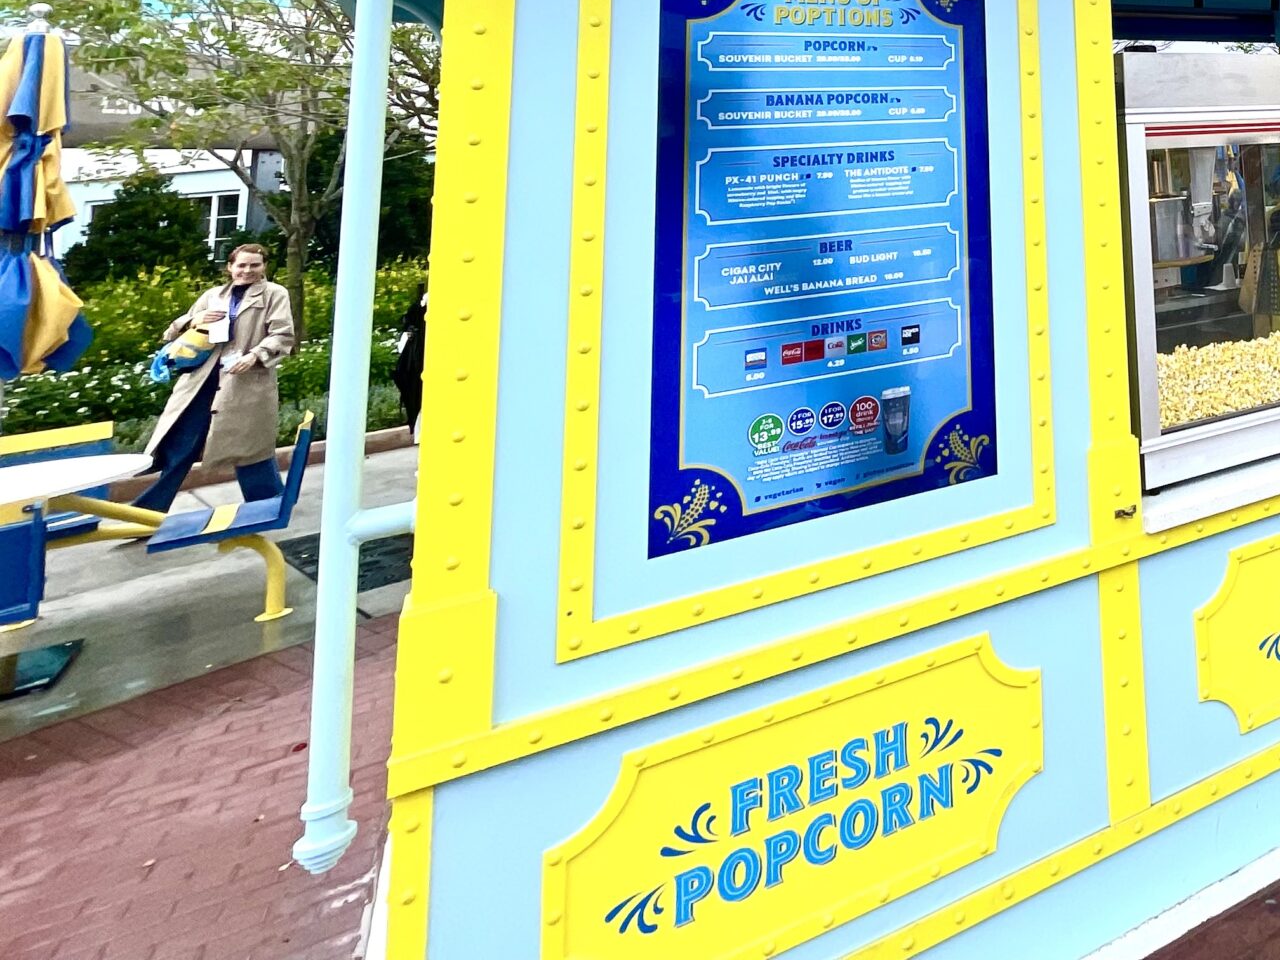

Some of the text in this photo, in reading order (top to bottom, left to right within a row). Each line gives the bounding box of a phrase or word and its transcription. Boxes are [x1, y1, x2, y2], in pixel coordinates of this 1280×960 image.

[773, 5, 894, 27] POPTIONS
[804, 40, 866, 52] POPCORN
[718, 54, 772, 63] SOUVENIR
[774, 54, 813, 63] BUCKET
[887, 55, 908, 63] CUP
[765, 93, 888, 107] BANANA POPCORN
[718, 111, 772, 121] SOUVENIR
[774, 110, 813, 119] BUCKET
[888, 107, 908, 116] CUP
[773, 150, 895, 168] SPECIALTY DRINKS
[725, 175, 757, 185] PX-41
[759, 172, 799, 183] PUNCH
[844, 169, 862, 178] THE
[863, 166, 909, 176] ANTIDOTE
[819, 239, 853, 254] BEER
[849, 254, 870, 265] BUD
[871, 251, 899, 262] LIGHT
[721, 264, 756, 277] CIGAR
[758, 262, 782, 273] CITY
[729, 272, 774, 285] JAI ALAI
[764, 284, 800, 295] WELL'S
[802, 278, 844, 291] BANANA
[845, 274, 878, 286] BREAD
[811, 319, 862, 337] DRINKS
[757, 441, 777, 450] BEST
[729, 721, 909, 838] FRESH
[673, 762, 955, 928] POPCORN
